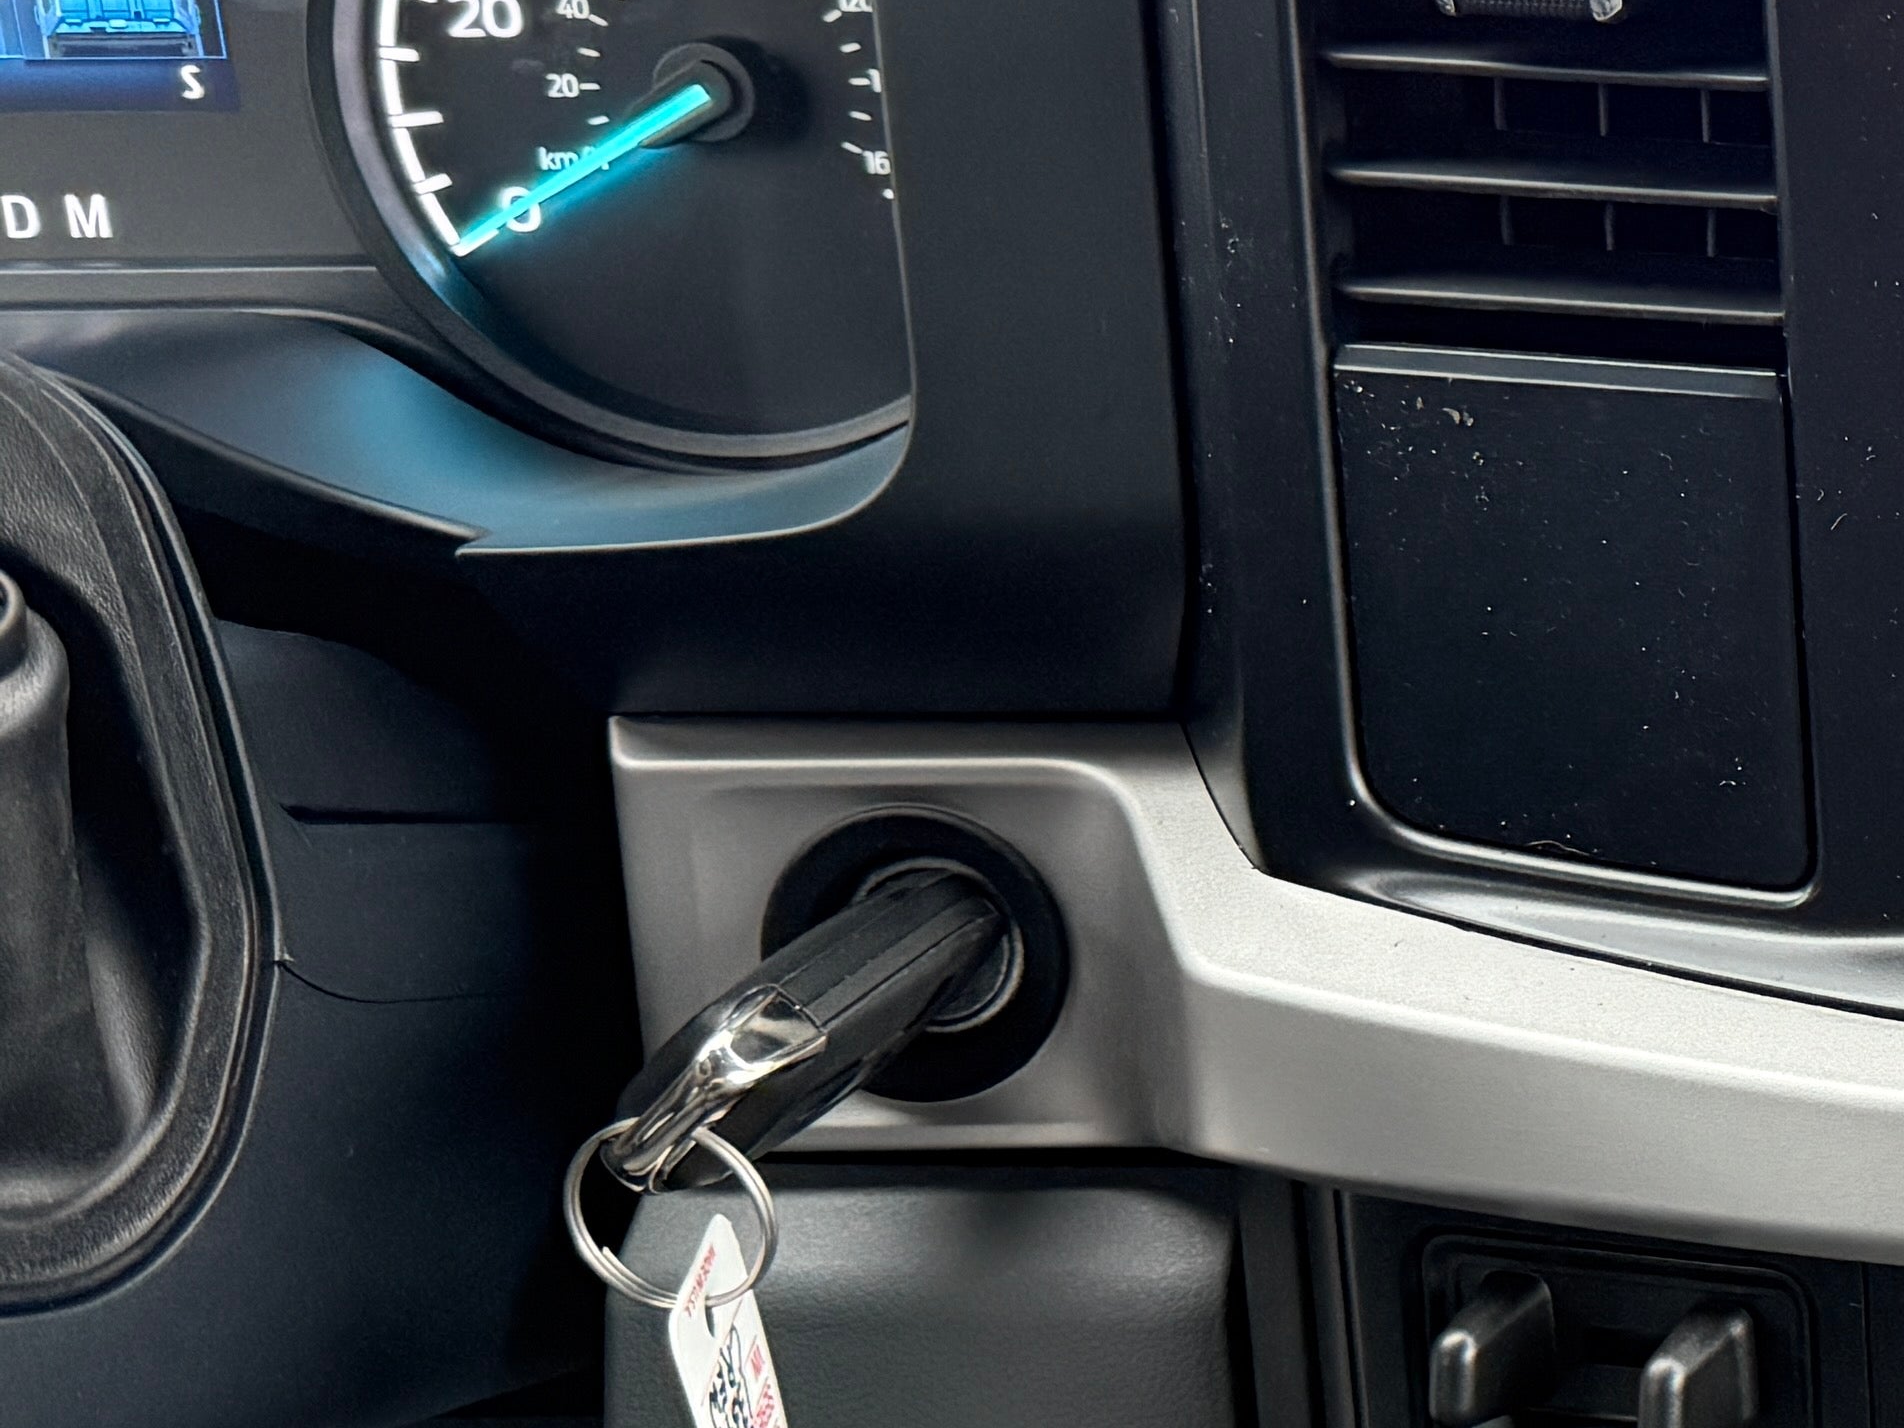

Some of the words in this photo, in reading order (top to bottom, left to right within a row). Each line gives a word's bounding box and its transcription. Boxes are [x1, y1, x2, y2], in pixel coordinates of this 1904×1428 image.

[178, 64, 206, 100] S
[546, 73, 580, 98] 20
[862, 149, 893, 176] 16
[0, 193, 42, 240] D
[63, 192, 114, 240] M
